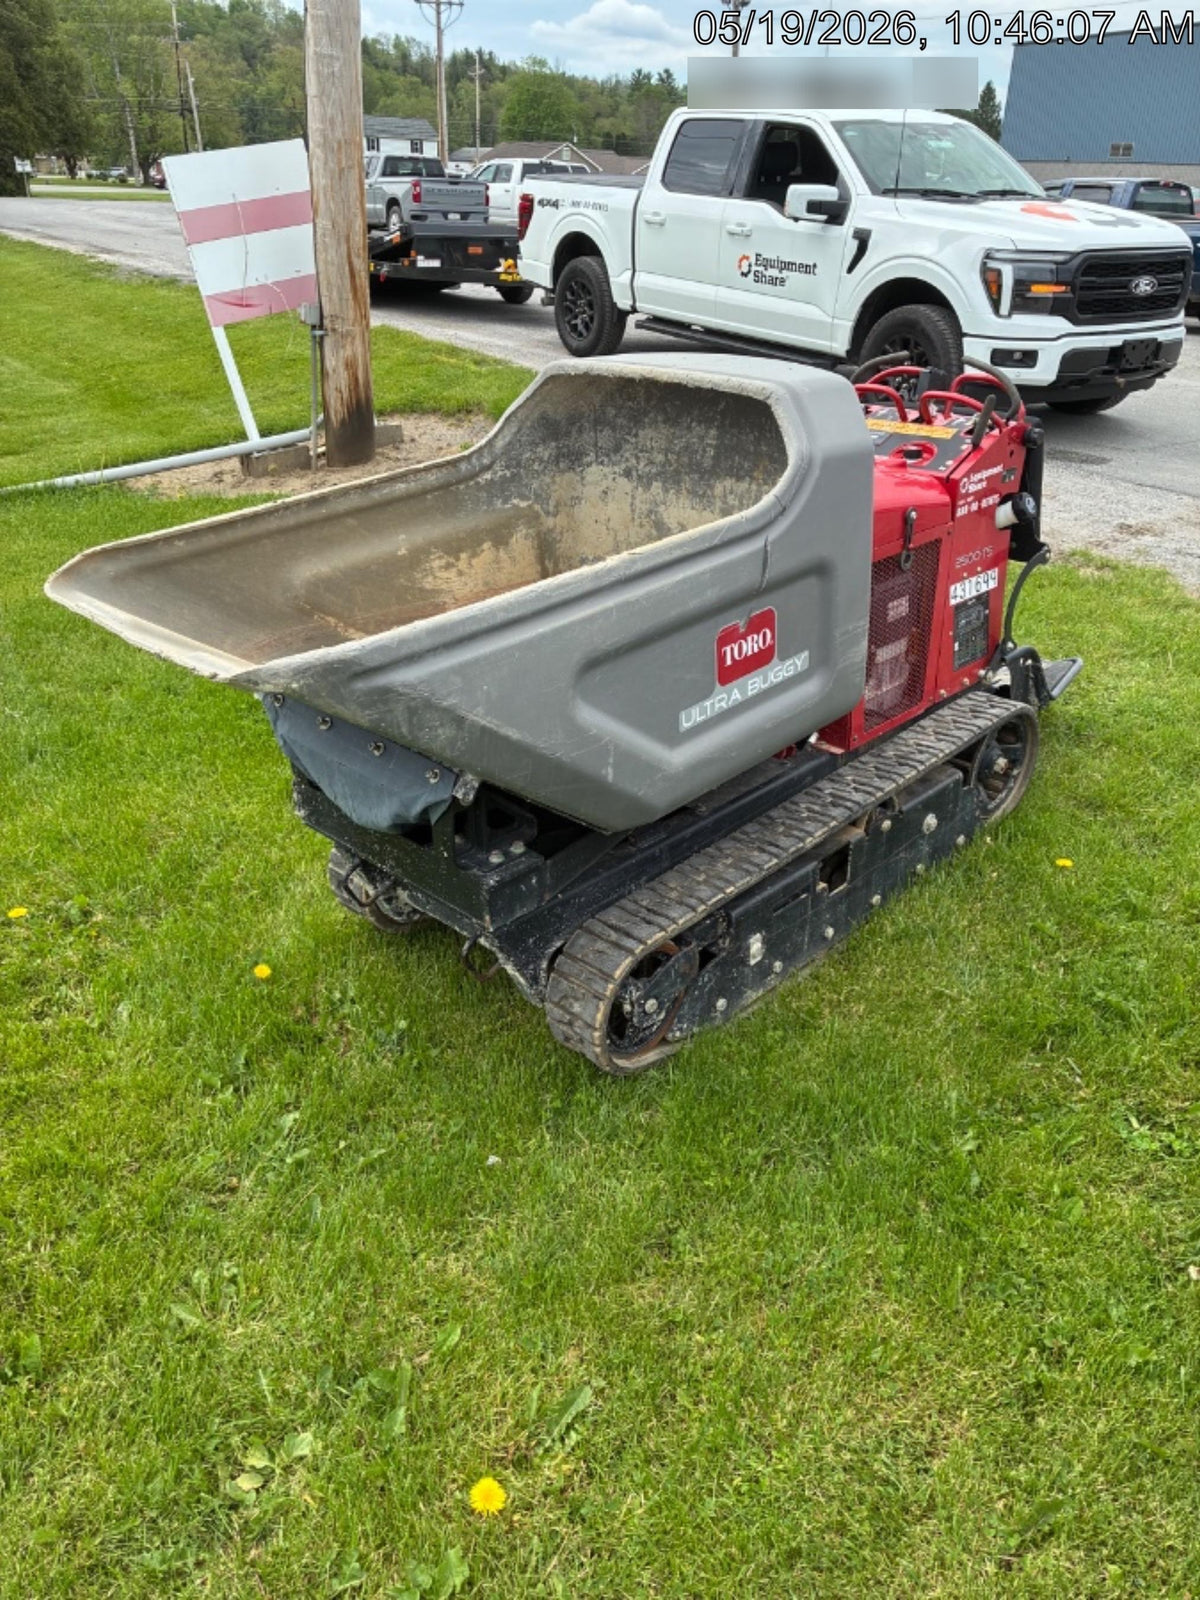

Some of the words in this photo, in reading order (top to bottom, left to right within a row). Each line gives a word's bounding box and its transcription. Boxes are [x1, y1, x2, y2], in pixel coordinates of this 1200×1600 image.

[753, 270, 786, 287] Share
[755, 253, 817, 276] Equipment
[721, 628, 772, 667] TORO
[681, 688, 742, 728] ULTRA
[747, 651, 808, 696] BUGGY
